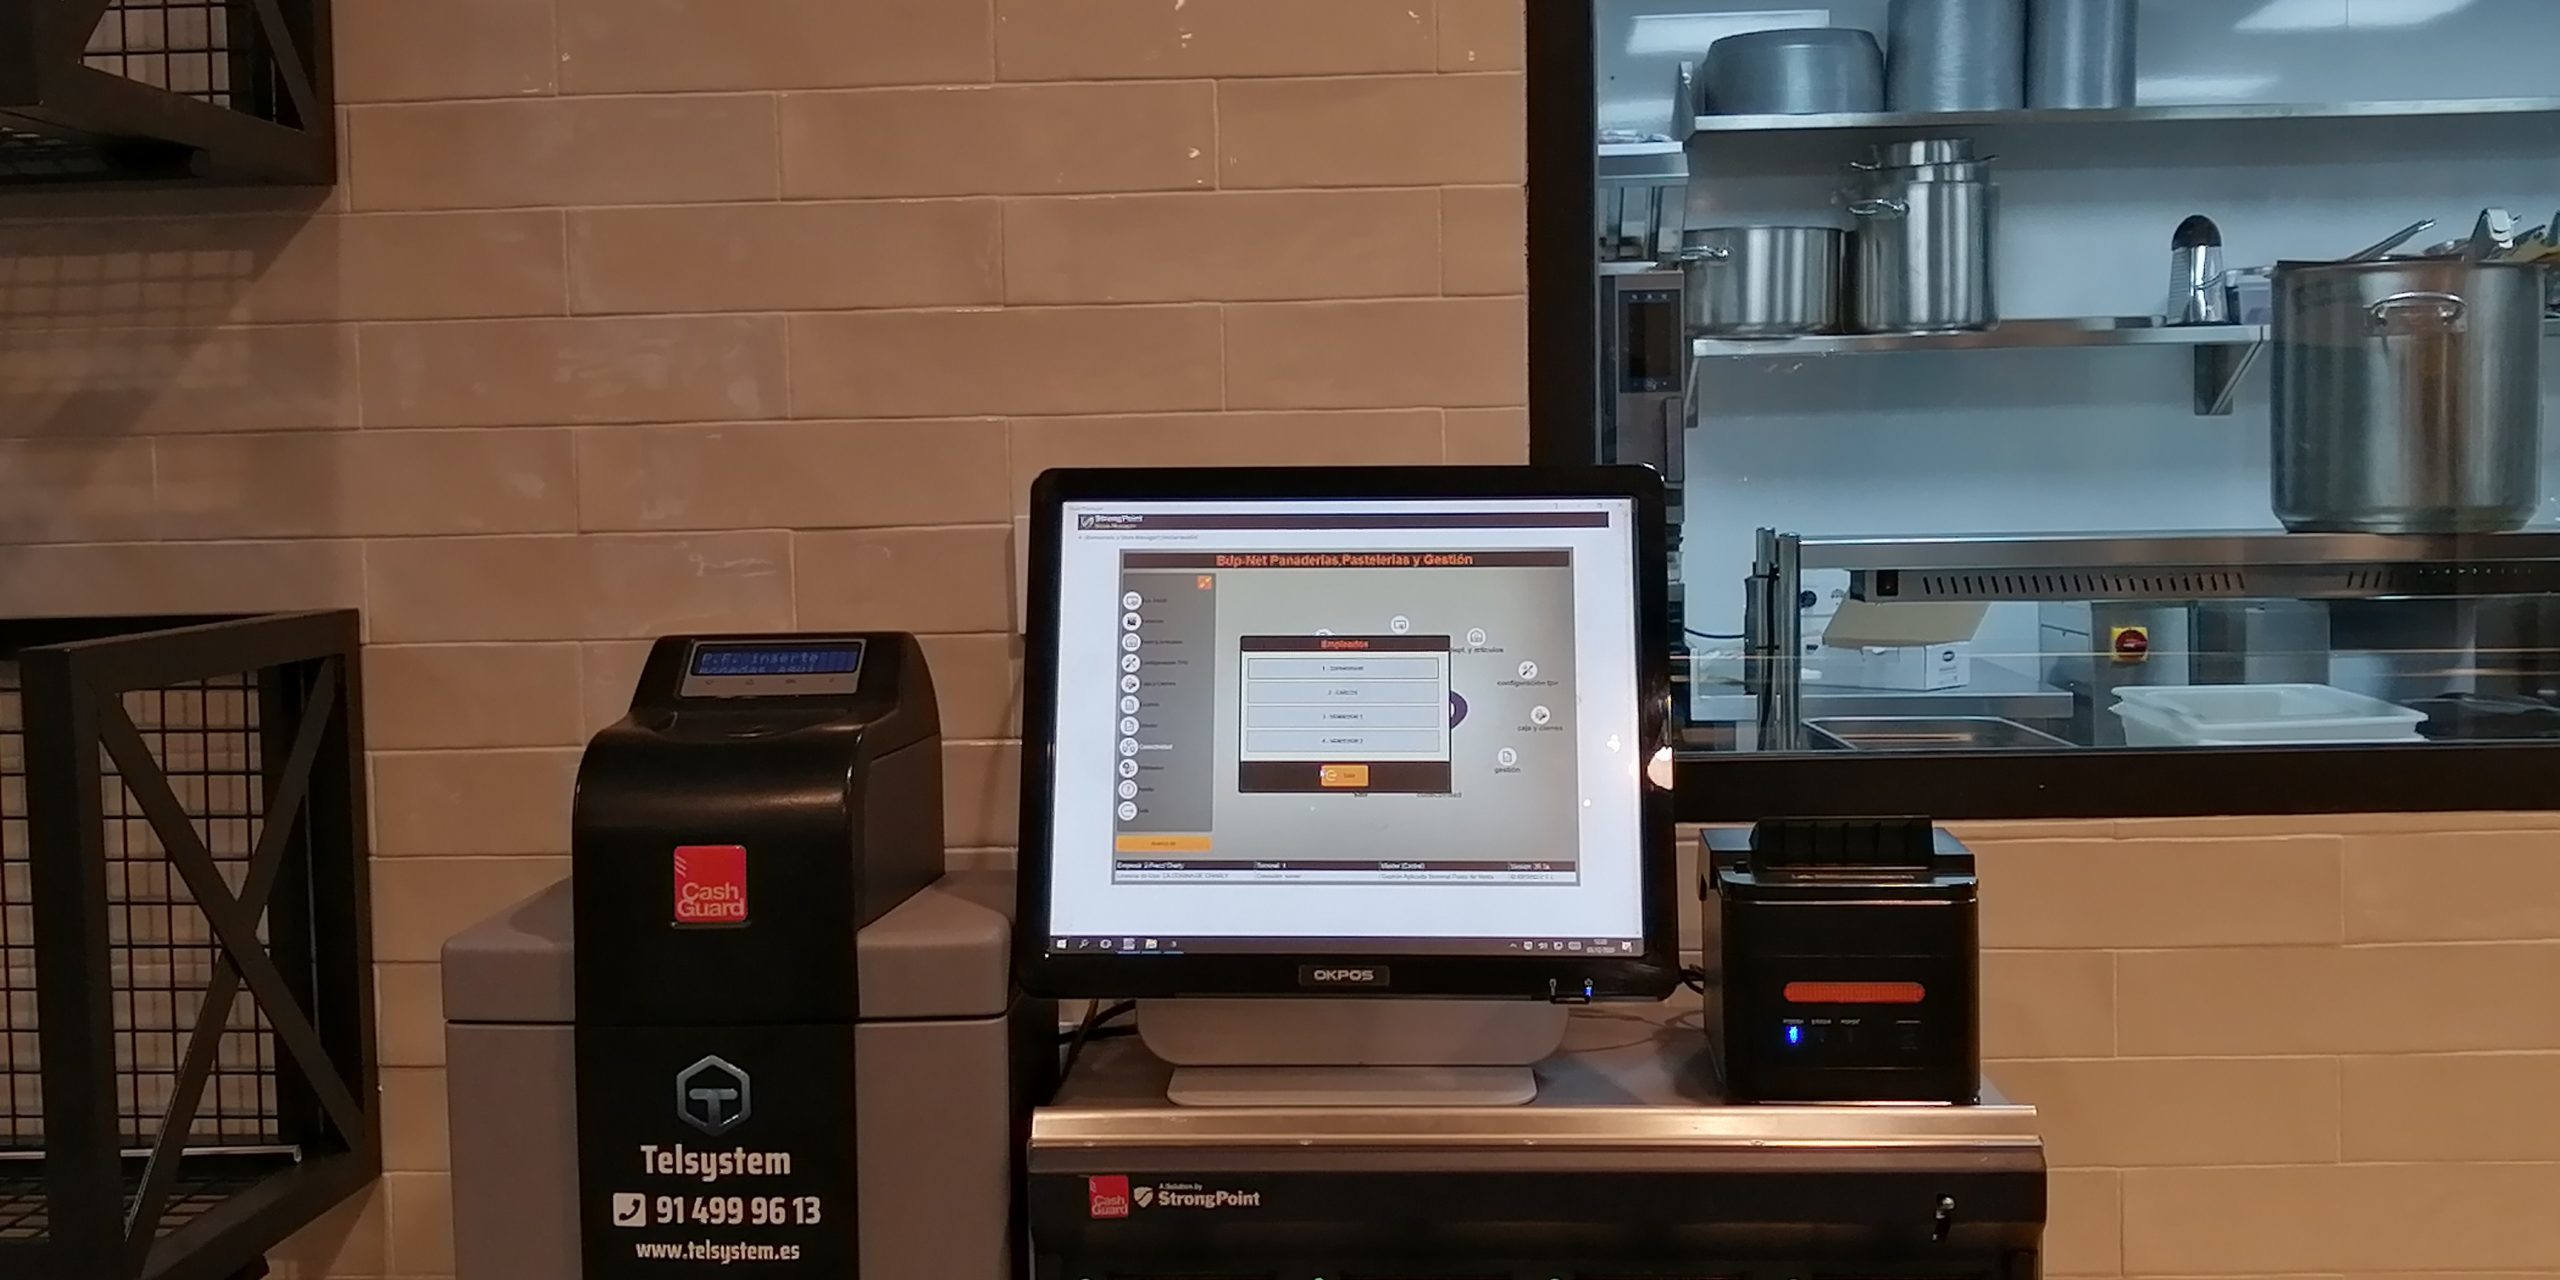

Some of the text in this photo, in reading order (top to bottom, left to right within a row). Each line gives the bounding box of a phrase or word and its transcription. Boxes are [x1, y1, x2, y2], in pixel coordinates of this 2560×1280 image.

[1413, 556, 1420, 568] y
[1320, 639, 1369, 650] Empleados
[681, 881, 740, 901] Cash
[676, 898, 745, 918] Guard
[1313, 969, 1375, 981] OKPOS
[640, 1144, 791, 1183] Telsystem
[1094, 1195, 1126, 1206] Cash
[1157, 1190, 1261, 1209] StrongPoint
[656, 1195, 822, 1226] 91 499 96 13
[1091, 1203, 1129, 1216] Guard
[635, 1239, 801, 1266] www.telsystem.es
